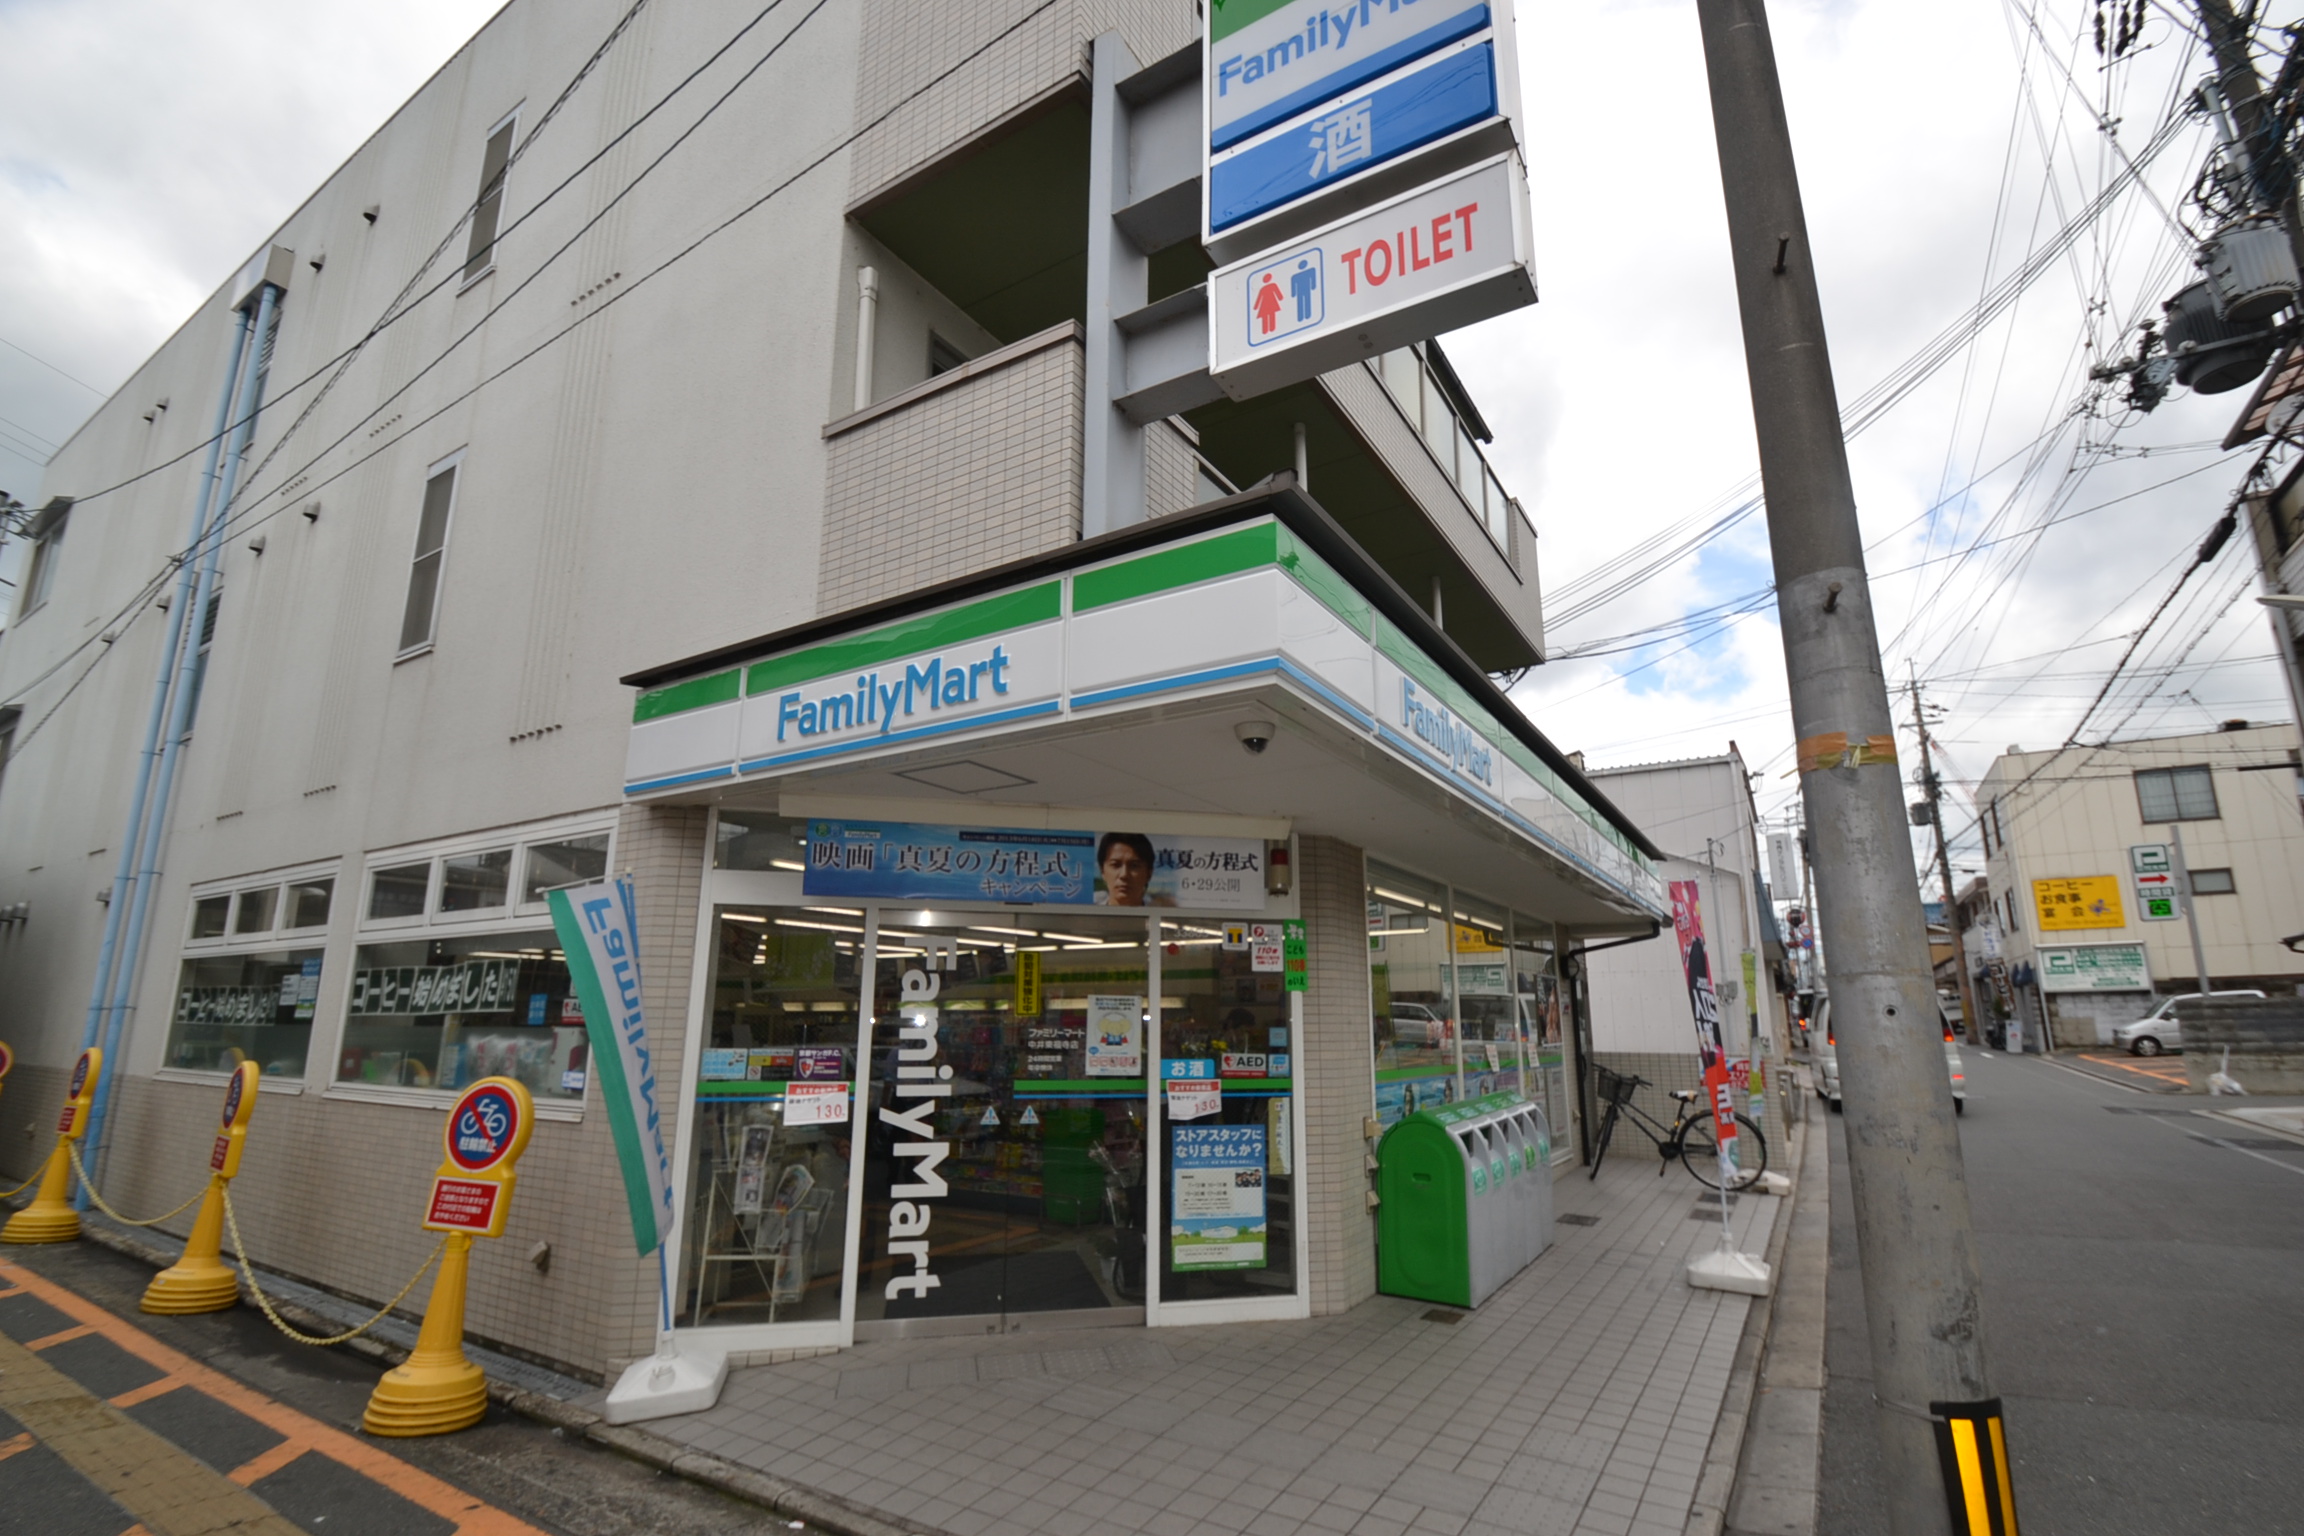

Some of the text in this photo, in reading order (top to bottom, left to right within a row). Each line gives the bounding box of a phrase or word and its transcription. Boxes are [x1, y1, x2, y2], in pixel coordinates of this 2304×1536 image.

[1308, 98, 1373, 179] 酒
[1341, 202, 1478, 295] TOILET
[777, 644, 1010, 741] FamilyMart
[1402, 676, 1493, 787] FamilyMart
[811, 841, 1082, 878] 映画「真夏の方程式」
[1156, 848, 1259, 872] 真夏の方程式
[981, 877, 1082, 897] キャンペーン
[2037, 881, 2093, 892] コーヒー
[2039, 893, 2082, 904] お食事
[1027, 1028, 1086, 1038] ファミリーマート
[1171, 1061, 1205, 1077] お酒
[1236, 1056, 1264, 1067] AED
[878, 936, 957, 1300] FamilyMart
[1175, 1129, 1263, 1142] ストアスタッフに
